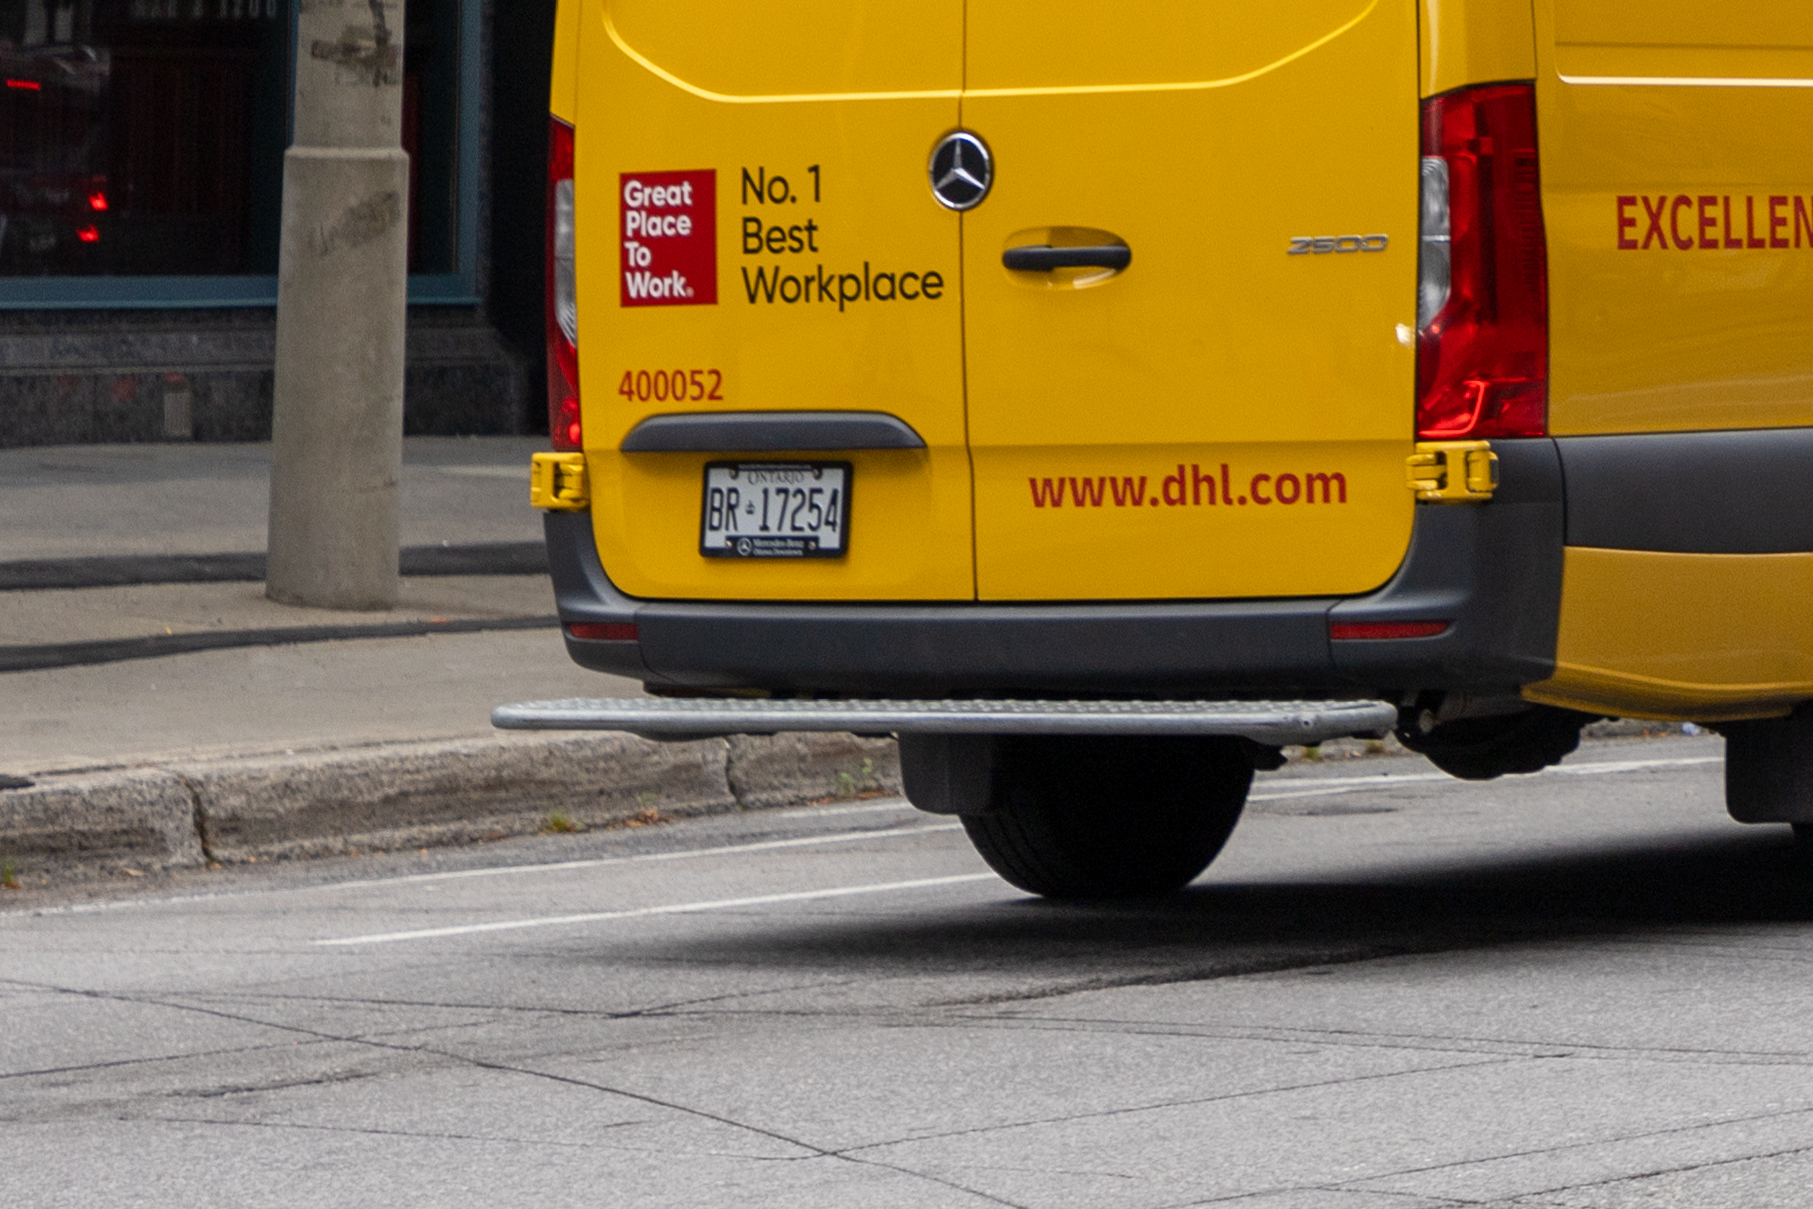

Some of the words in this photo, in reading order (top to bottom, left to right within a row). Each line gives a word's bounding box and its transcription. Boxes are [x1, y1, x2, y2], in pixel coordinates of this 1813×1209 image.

[624, 179, 693, 207] Great
[741, 166, 797, 205] No.
[807, 164, 820, 203] 1
[625, 210, 692, 238] Place
[742, 216, 819, 254] Best
[624, 240, 652, 268] To
[1287, 234, 1389, 256] 2500
[740, 261, 944, 313] Workplace
[617, 368, 724, 402] 400052
[748, 470, 805, 485] ONTARIO
[1028, 462, 1348, 508] www.dhl.com
